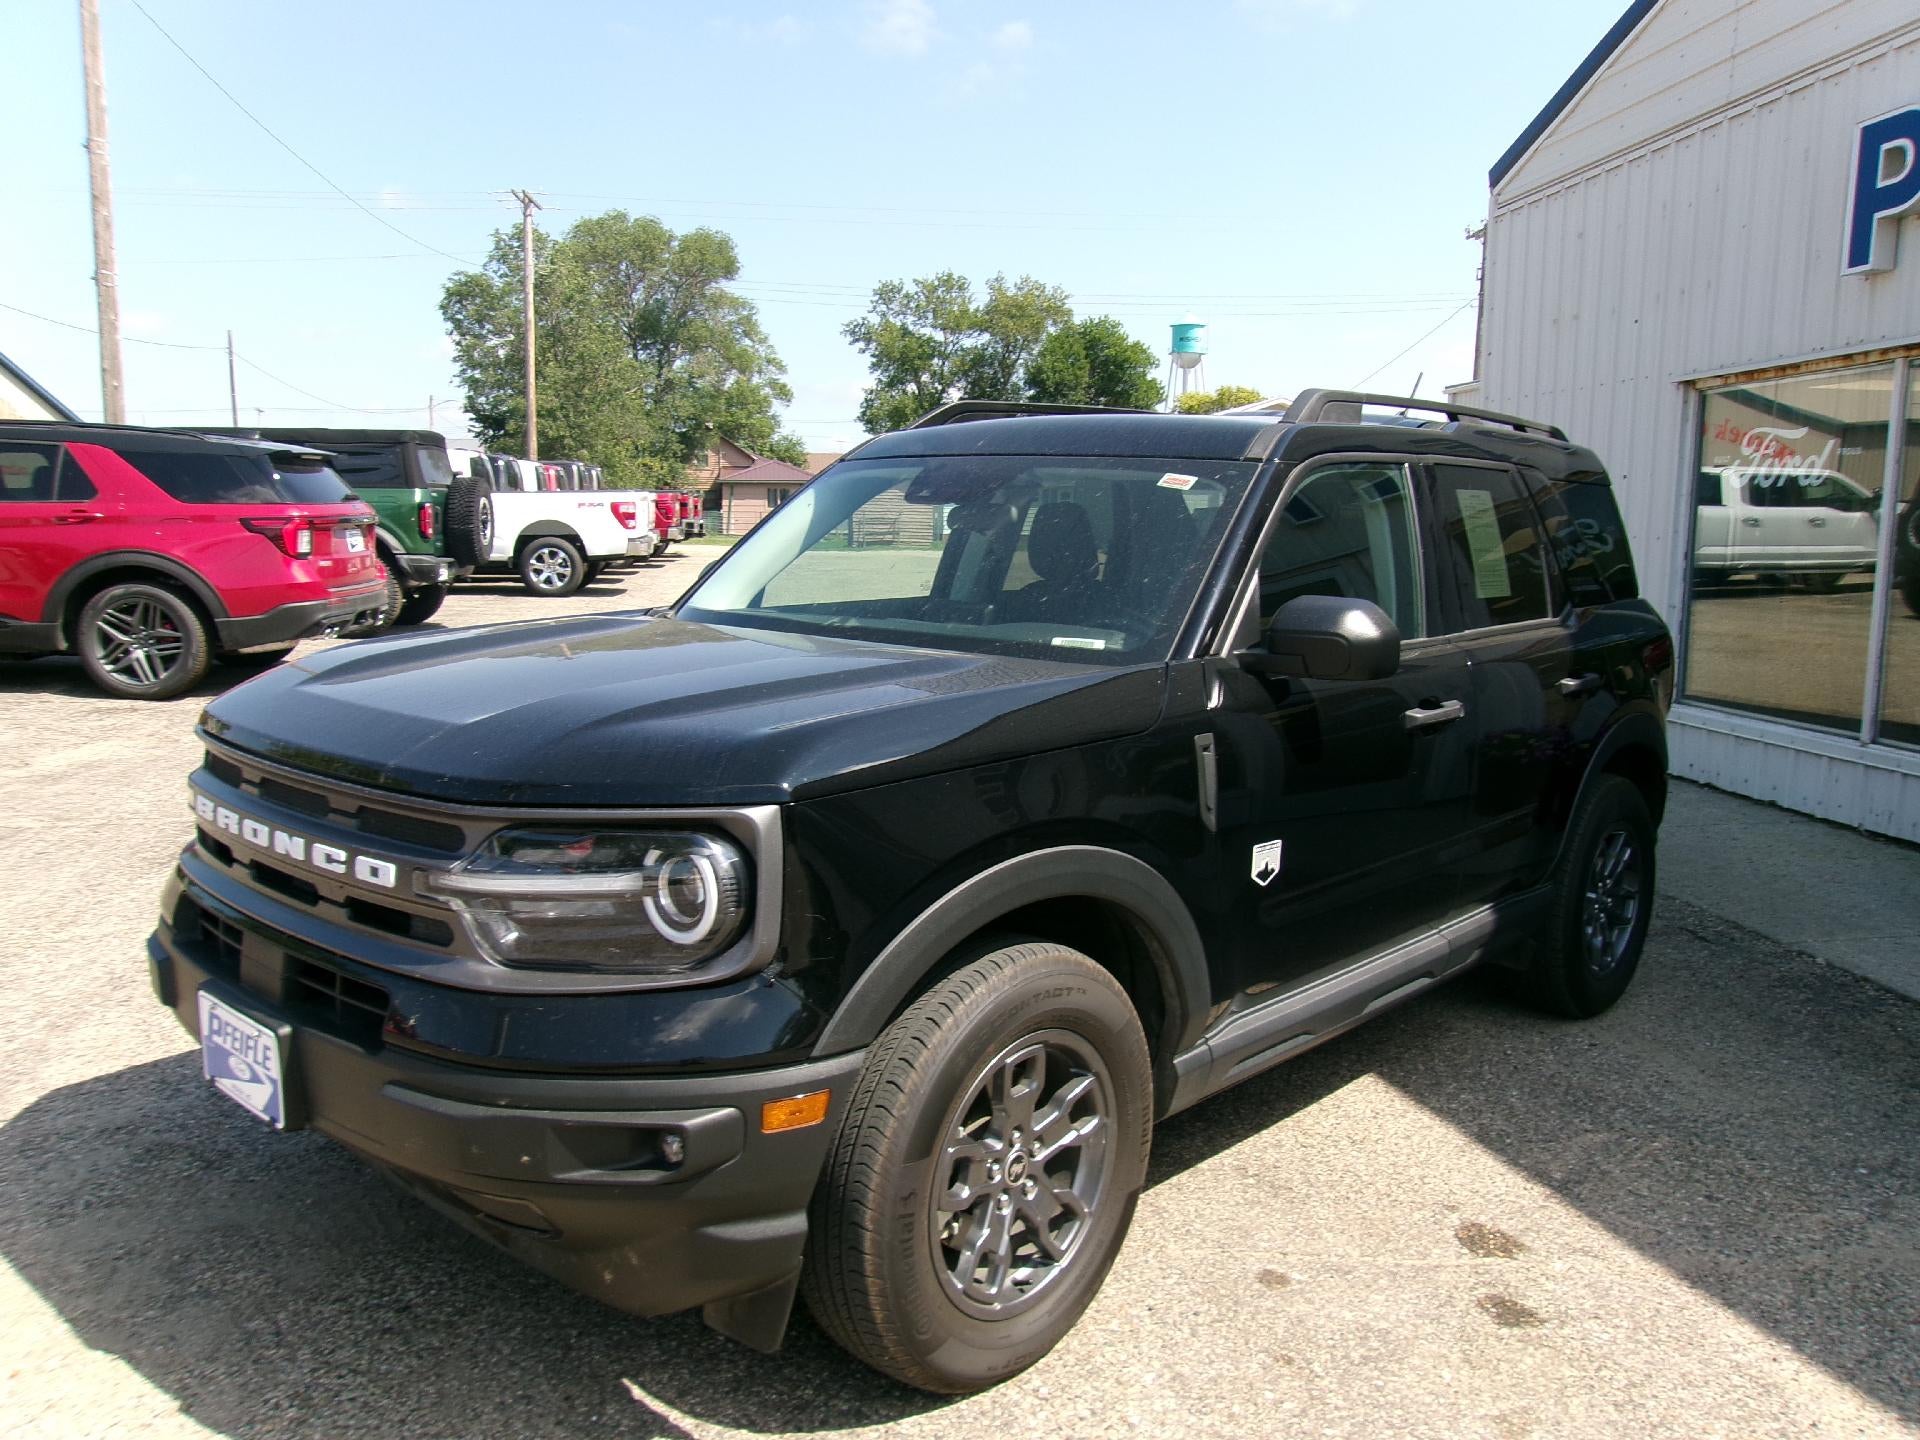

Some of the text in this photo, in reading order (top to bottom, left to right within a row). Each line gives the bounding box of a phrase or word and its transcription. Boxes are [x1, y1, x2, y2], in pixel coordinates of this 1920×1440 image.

[1729, 426, 1841, 489] Ford
[196, 795, 396, 888] BRONCO
[208, 1010, 272, 1071] PFEIFLE
